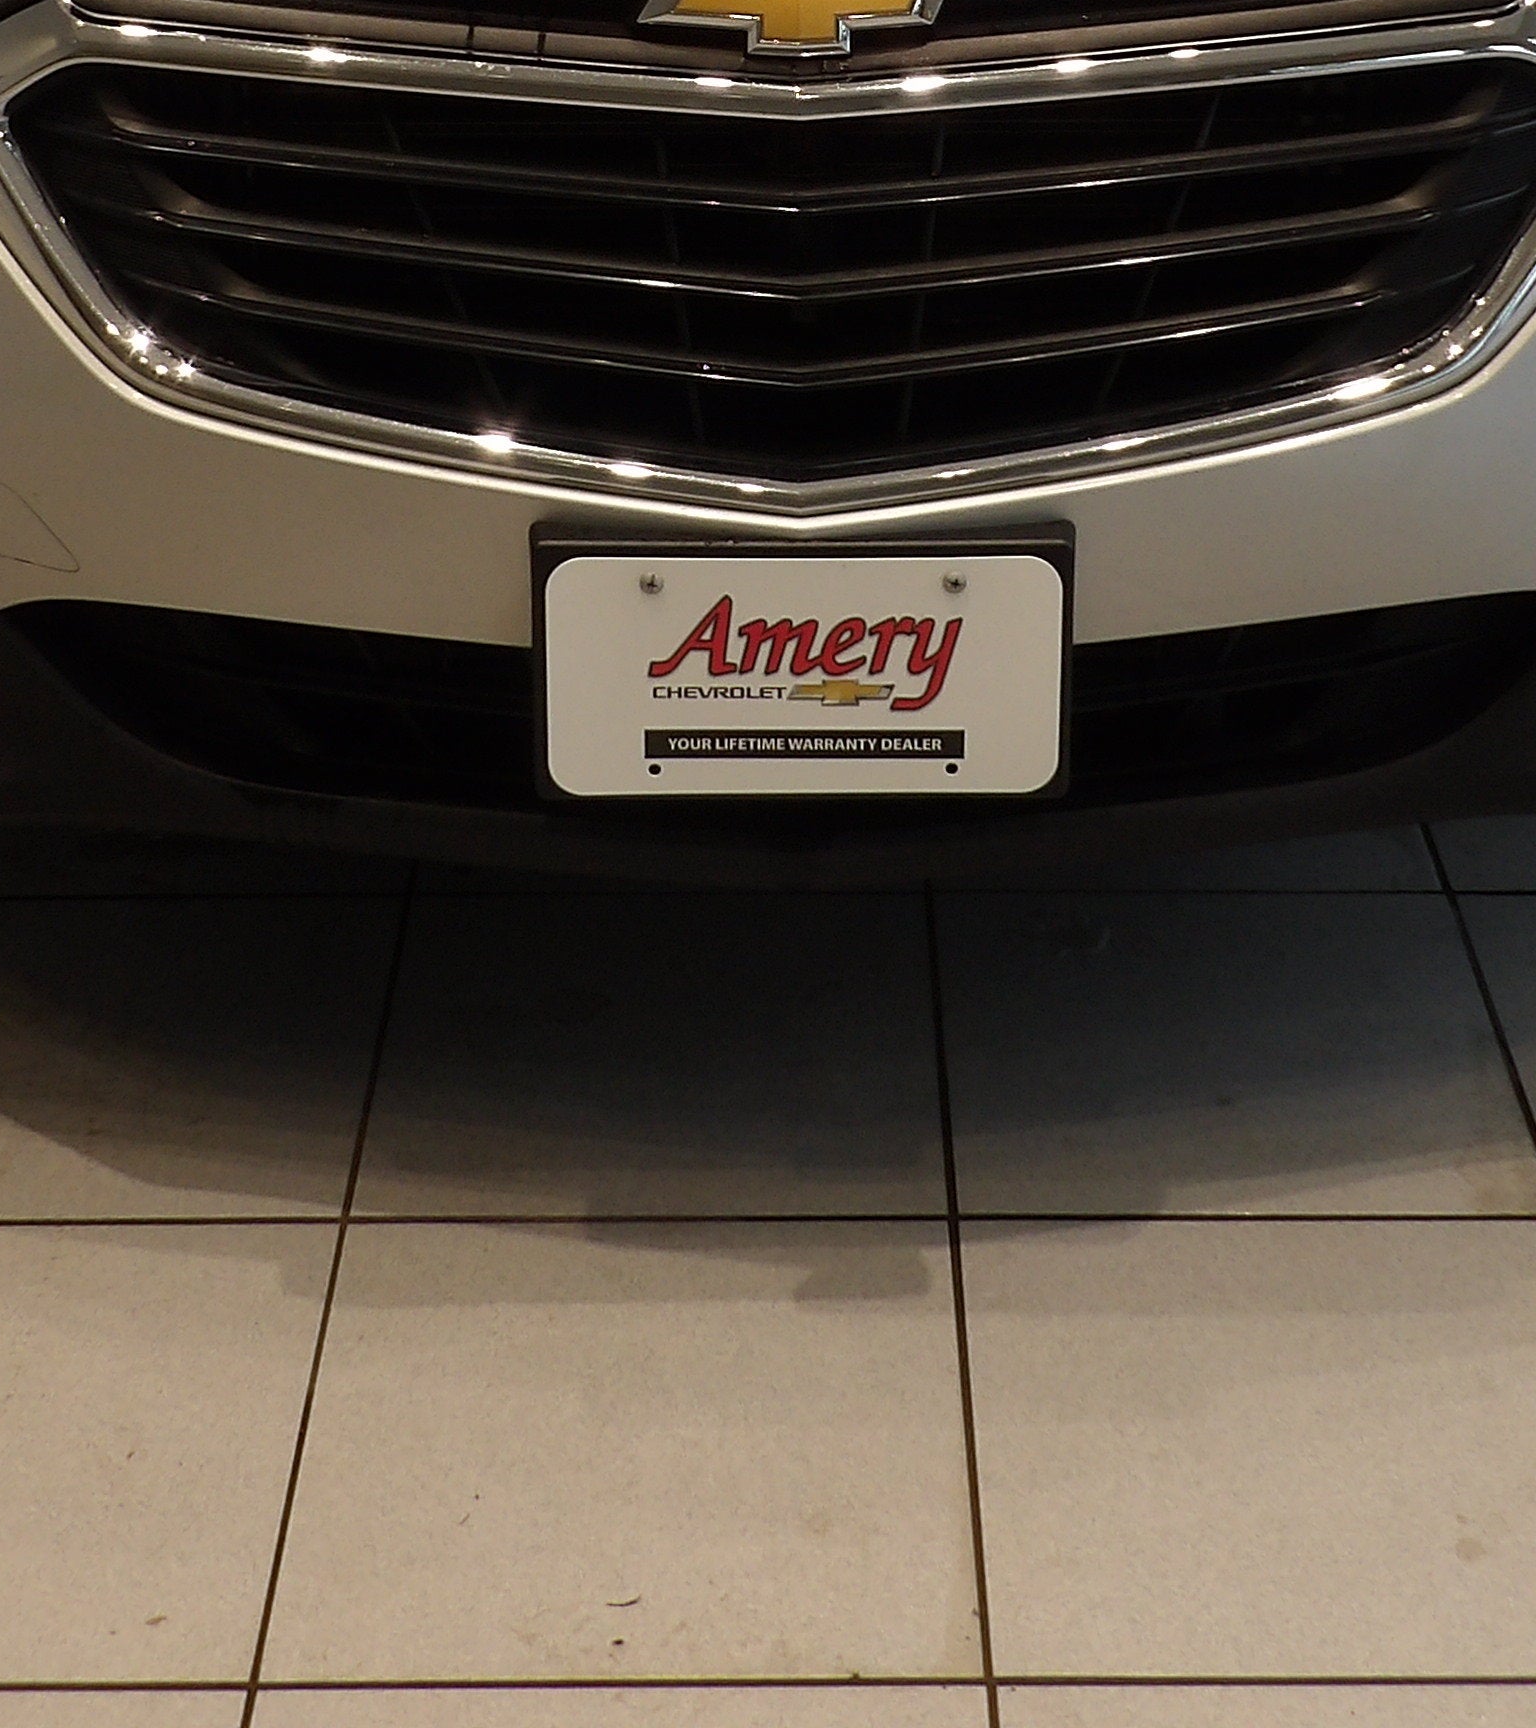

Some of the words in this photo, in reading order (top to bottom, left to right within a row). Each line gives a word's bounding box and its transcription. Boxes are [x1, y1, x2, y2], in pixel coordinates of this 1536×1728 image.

[648, 594, 963, 709] Amery
[652, 686, 787, 699] CHEVROLET
[668, 737, 711, 751] YOUR
[715, 737, 785, 751] LIFETIME
[789, 737, 877, 751] WARRANTY
[881, 737, 942, 751] DEALER
